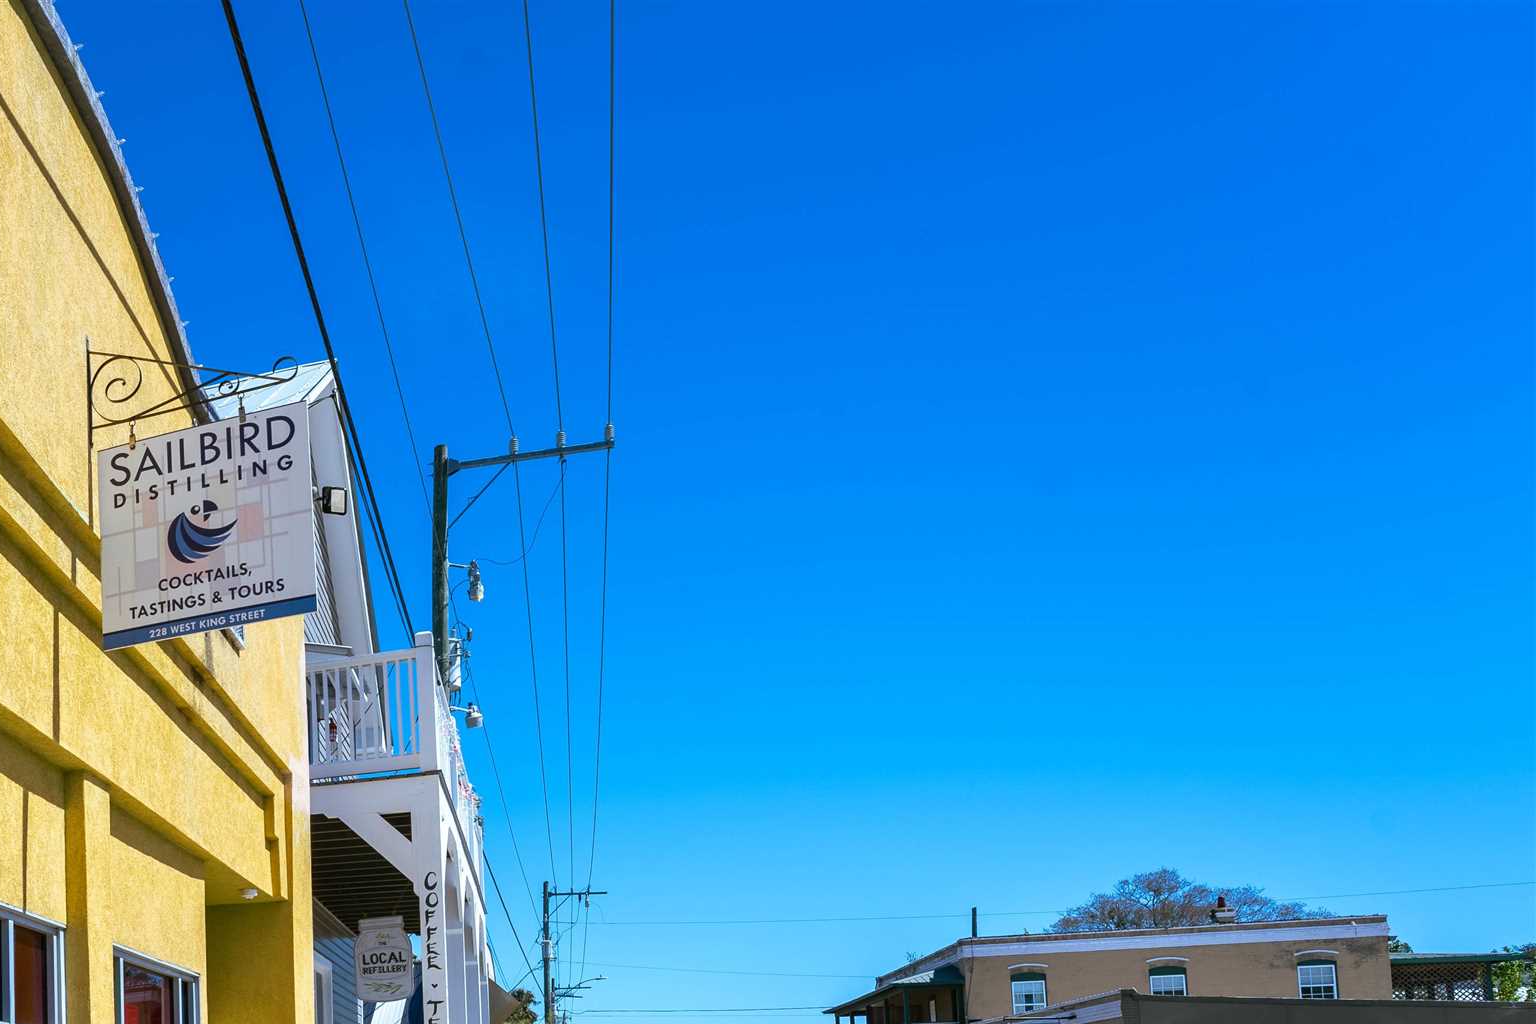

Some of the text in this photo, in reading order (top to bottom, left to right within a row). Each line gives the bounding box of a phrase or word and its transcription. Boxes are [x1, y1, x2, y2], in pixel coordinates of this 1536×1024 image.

[110, 415, 295, 486] SAILBIRD
[114, 455, 294, 509] DISTILLING
[158, 563, 252, 592] COCKTAILS,
[129, 578, 285, 619] TASTINGS & TOURS
[148, 609, 265, 638] 228 WEST KING STREET
[424, 871, 442, 970] COFFEE
[362, 952, 407, 965] LOCAL
[362, 964, 407, 975] REFILLERY
